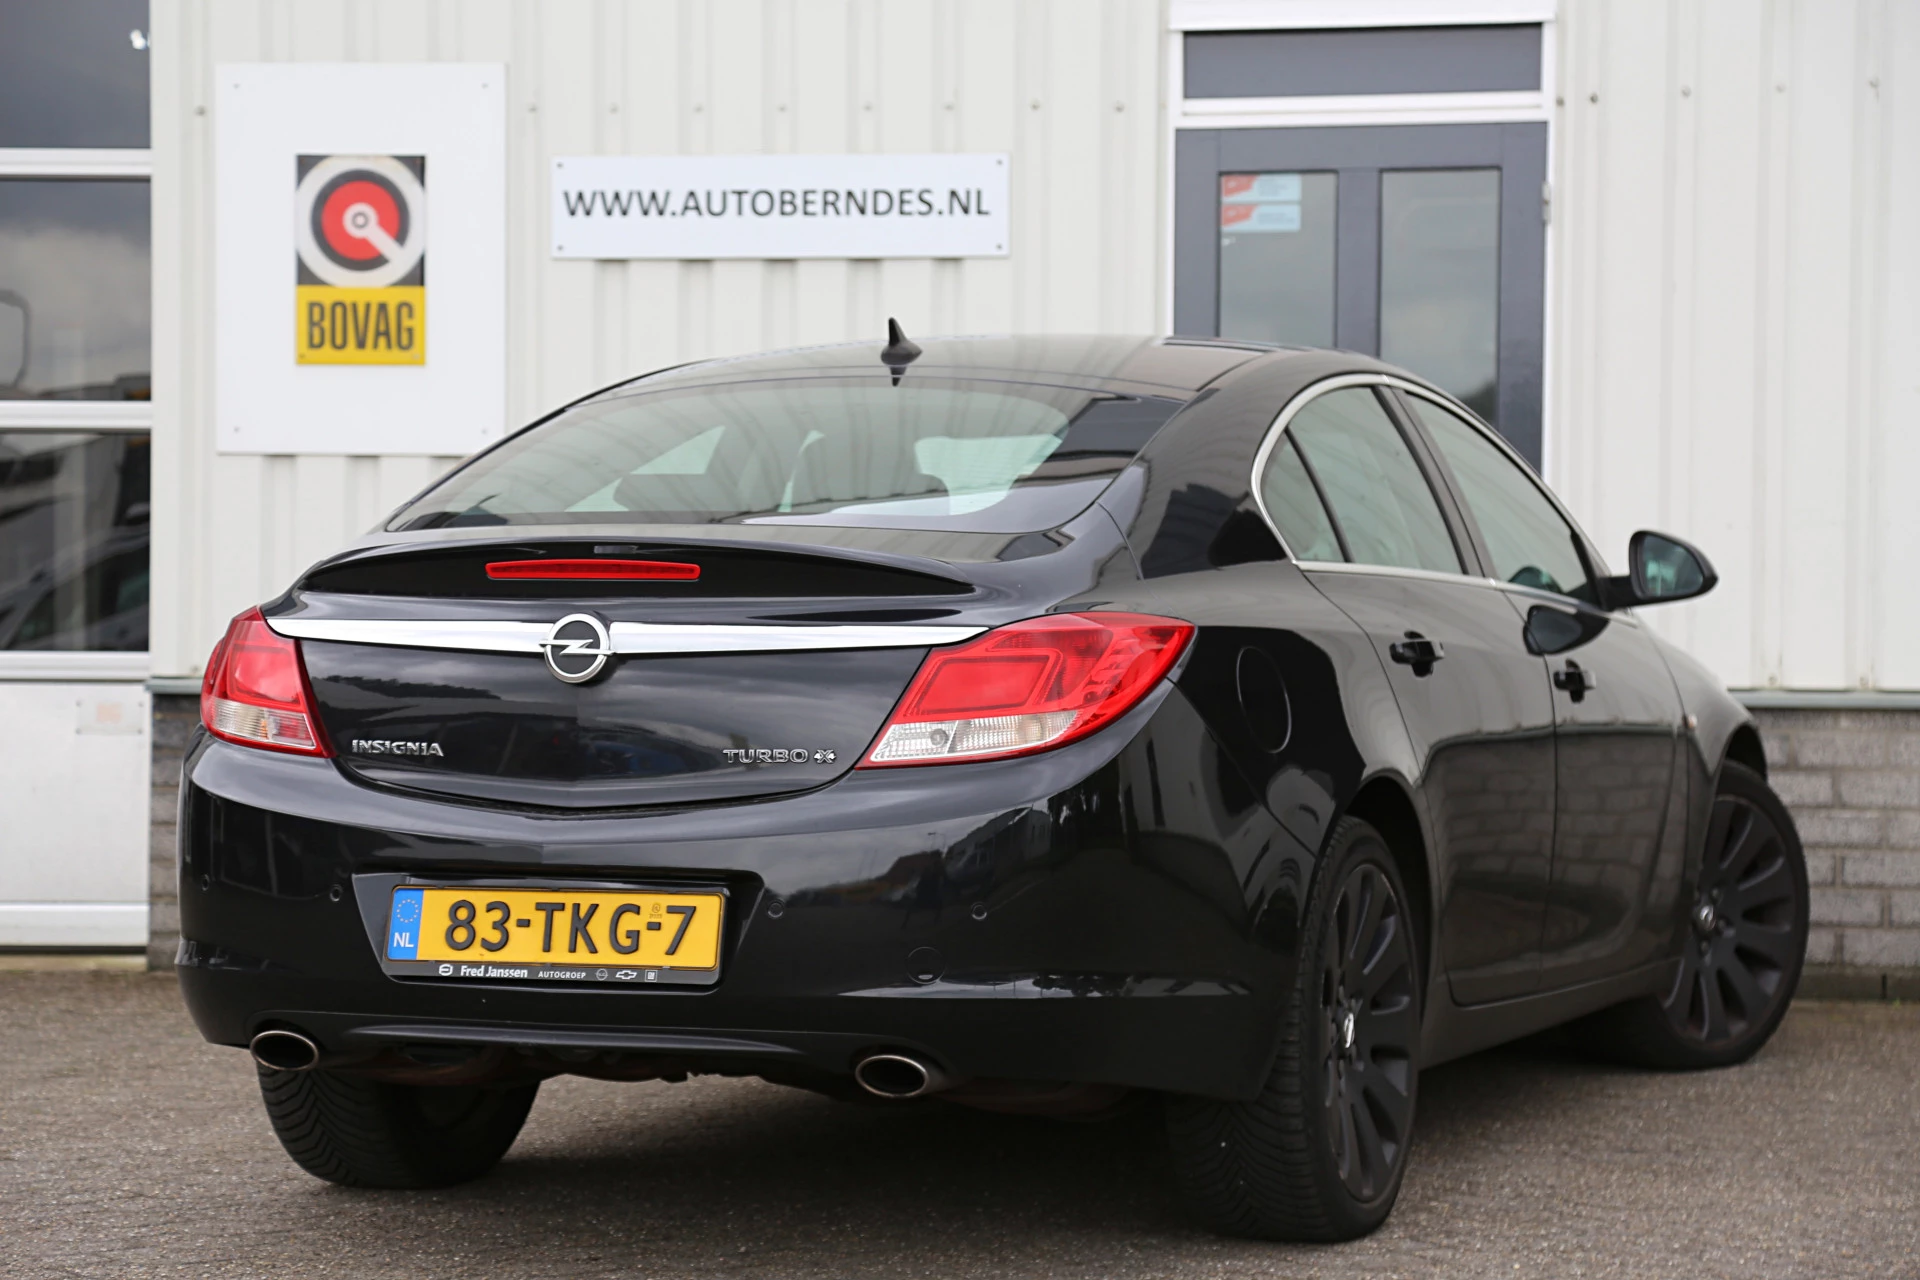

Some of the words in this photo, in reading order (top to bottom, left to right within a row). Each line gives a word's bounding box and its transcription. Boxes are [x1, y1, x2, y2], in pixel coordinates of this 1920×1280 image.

[564, 188, 990, 219] WWW.AUTOBERNDES.NL
[307, 301, 415, 352] BOVAG
[351, 738, 444, 758] INSIGNIA
[722, 748, 808, 763] TURBO
[445, 899, 697, 956] 83-TKG-7
[393, 932, 414, 949] NL
[460, 965, 485, 977] Fred
[485, 966, 528, 978] Janssen
[538, 970, 586, 979] AUTOGROEP
